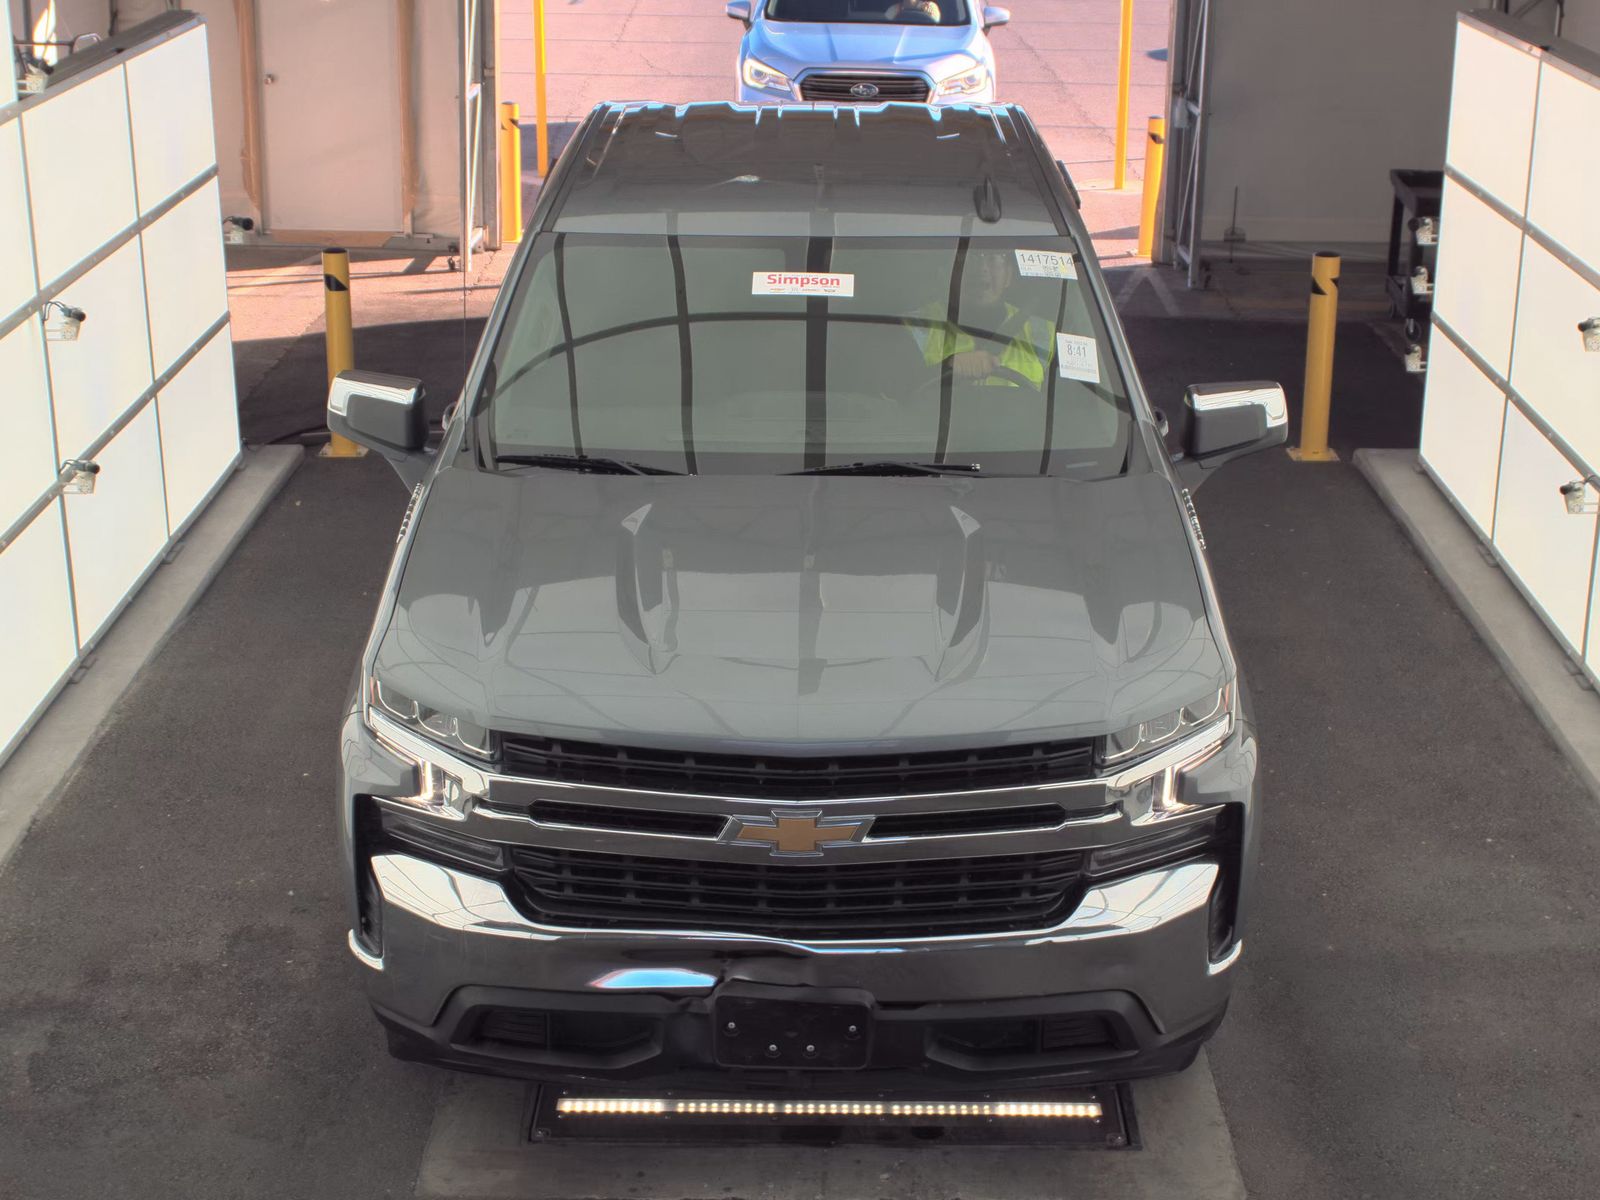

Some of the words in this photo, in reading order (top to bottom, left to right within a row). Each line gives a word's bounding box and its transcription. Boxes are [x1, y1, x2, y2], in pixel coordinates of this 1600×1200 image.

[1020, 253, 1074, 266] 1417514
[767, 274, 840, 288] Simpson
[1067, 343, 1087, 357] 8:41
